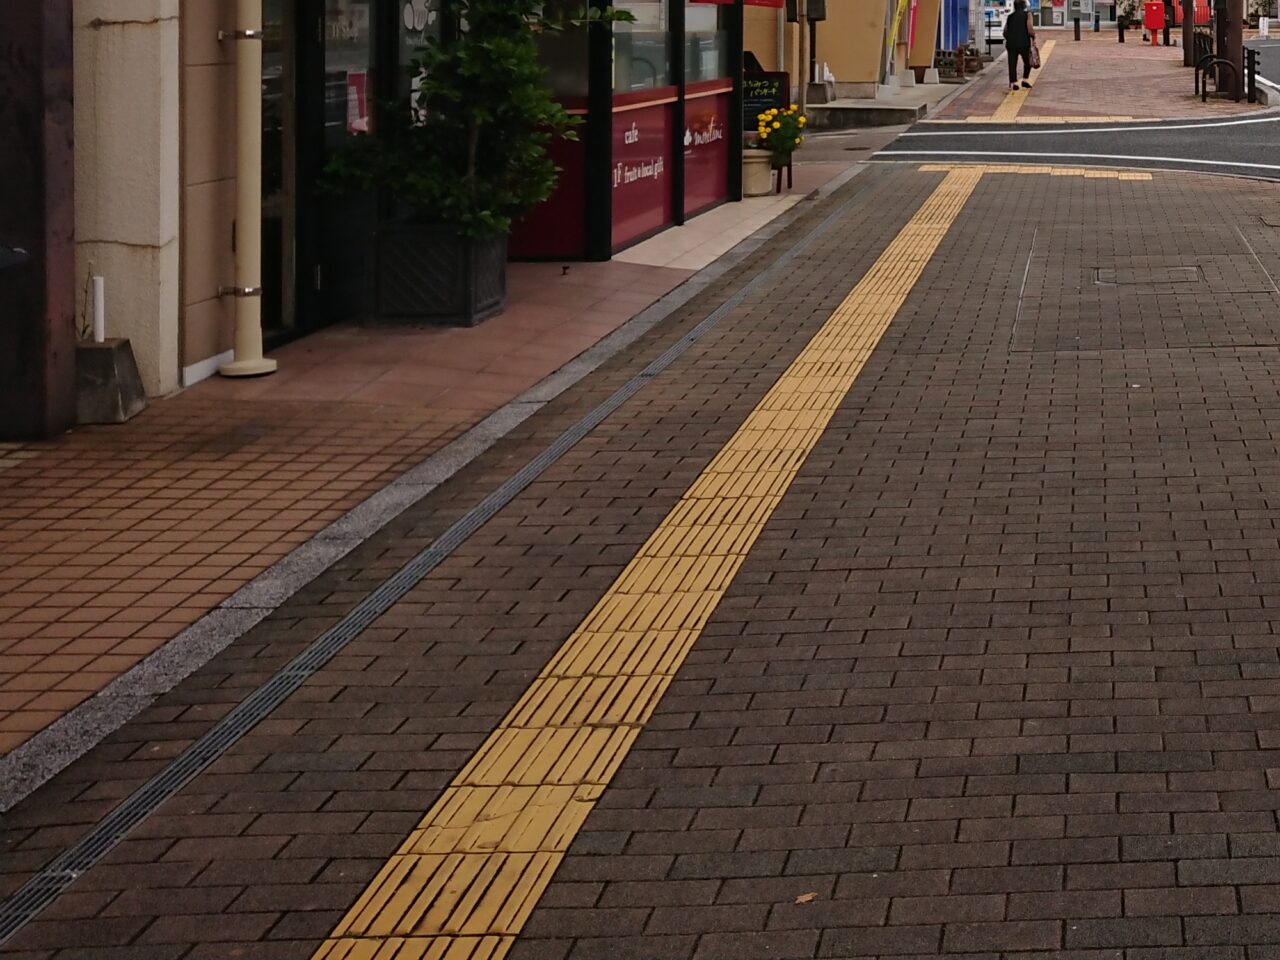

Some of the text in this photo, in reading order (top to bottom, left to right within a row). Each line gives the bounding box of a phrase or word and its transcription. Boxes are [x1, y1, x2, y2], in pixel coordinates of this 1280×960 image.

[624, 121, 639, 144] cafe
[613, 162, 623, 188] 1F
[641, 159, 654, 178] local
